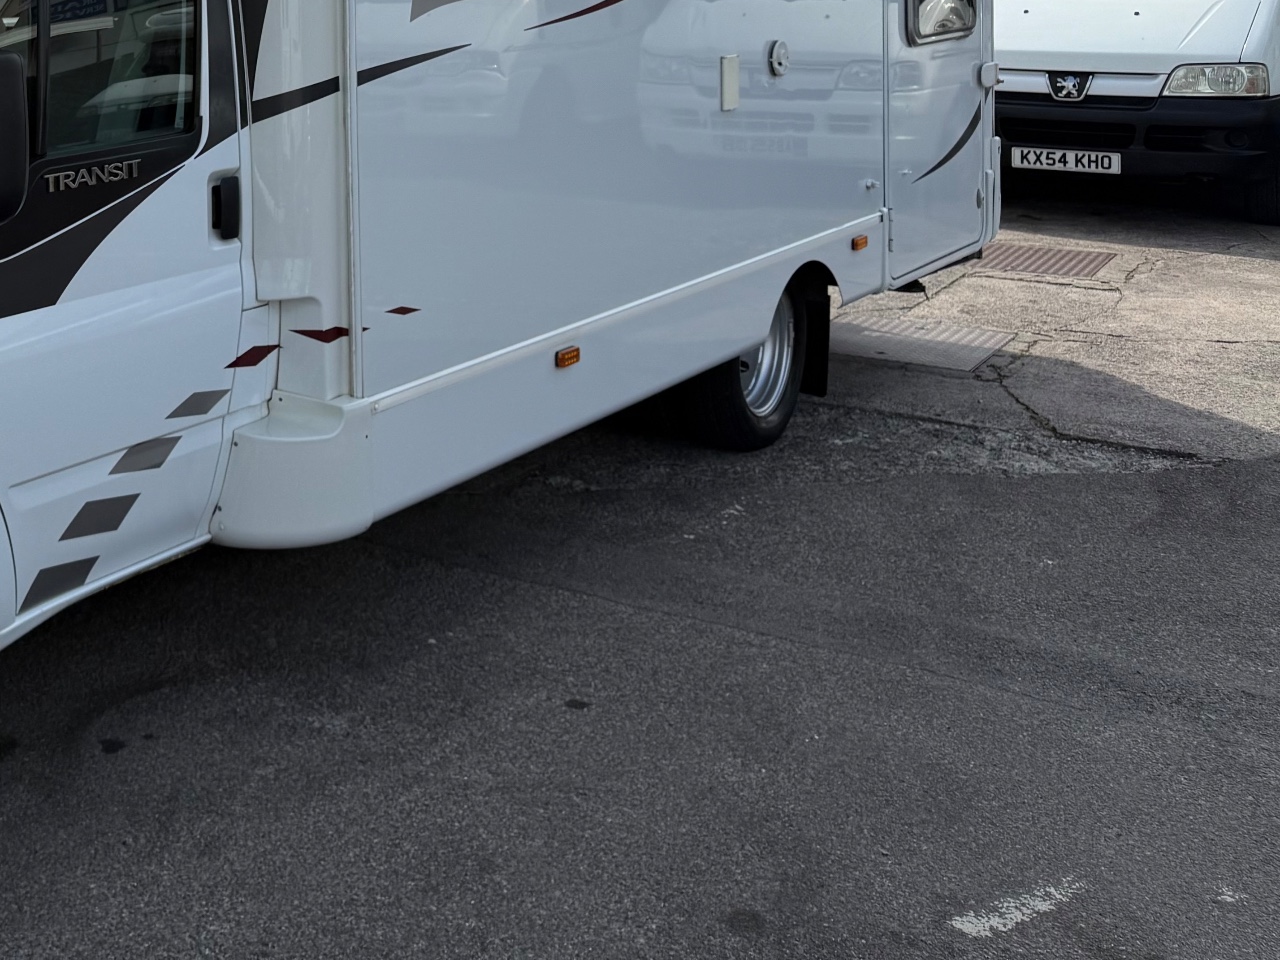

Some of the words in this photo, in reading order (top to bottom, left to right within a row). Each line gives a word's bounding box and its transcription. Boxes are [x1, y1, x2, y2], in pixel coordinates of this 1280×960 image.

[1019, 149, 1069, 168] KX54
[1074, 152, 1112, 171] KHO
[43, 158, 142, 193] TRANSIT
